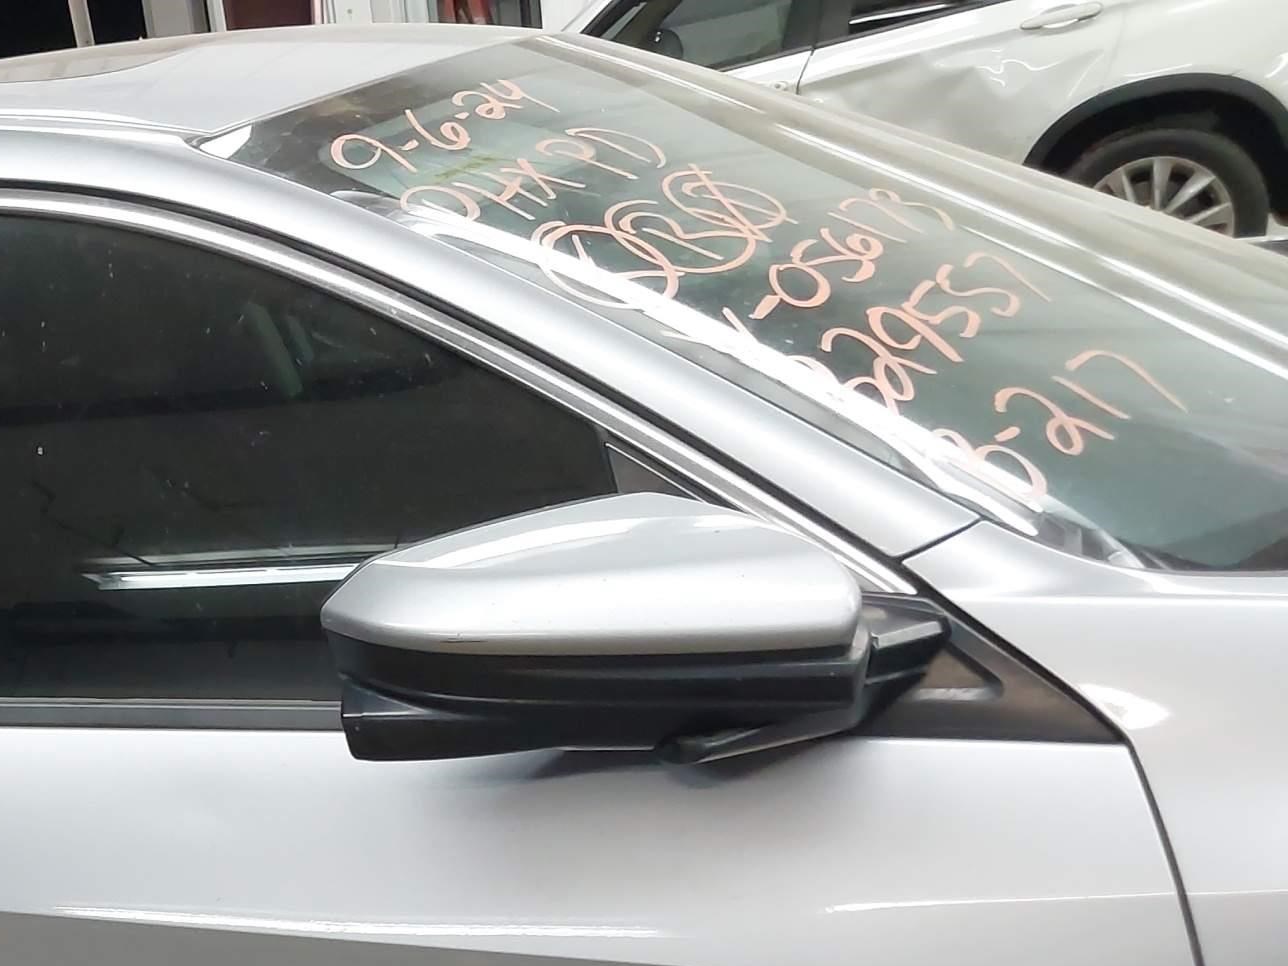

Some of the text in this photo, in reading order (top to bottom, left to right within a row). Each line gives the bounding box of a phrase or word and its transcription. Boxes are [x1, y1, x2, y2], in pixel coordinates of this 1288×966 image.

[331, 80, 561, 172] 9-6-24
[400, 128, 666, 222] PHX PD
